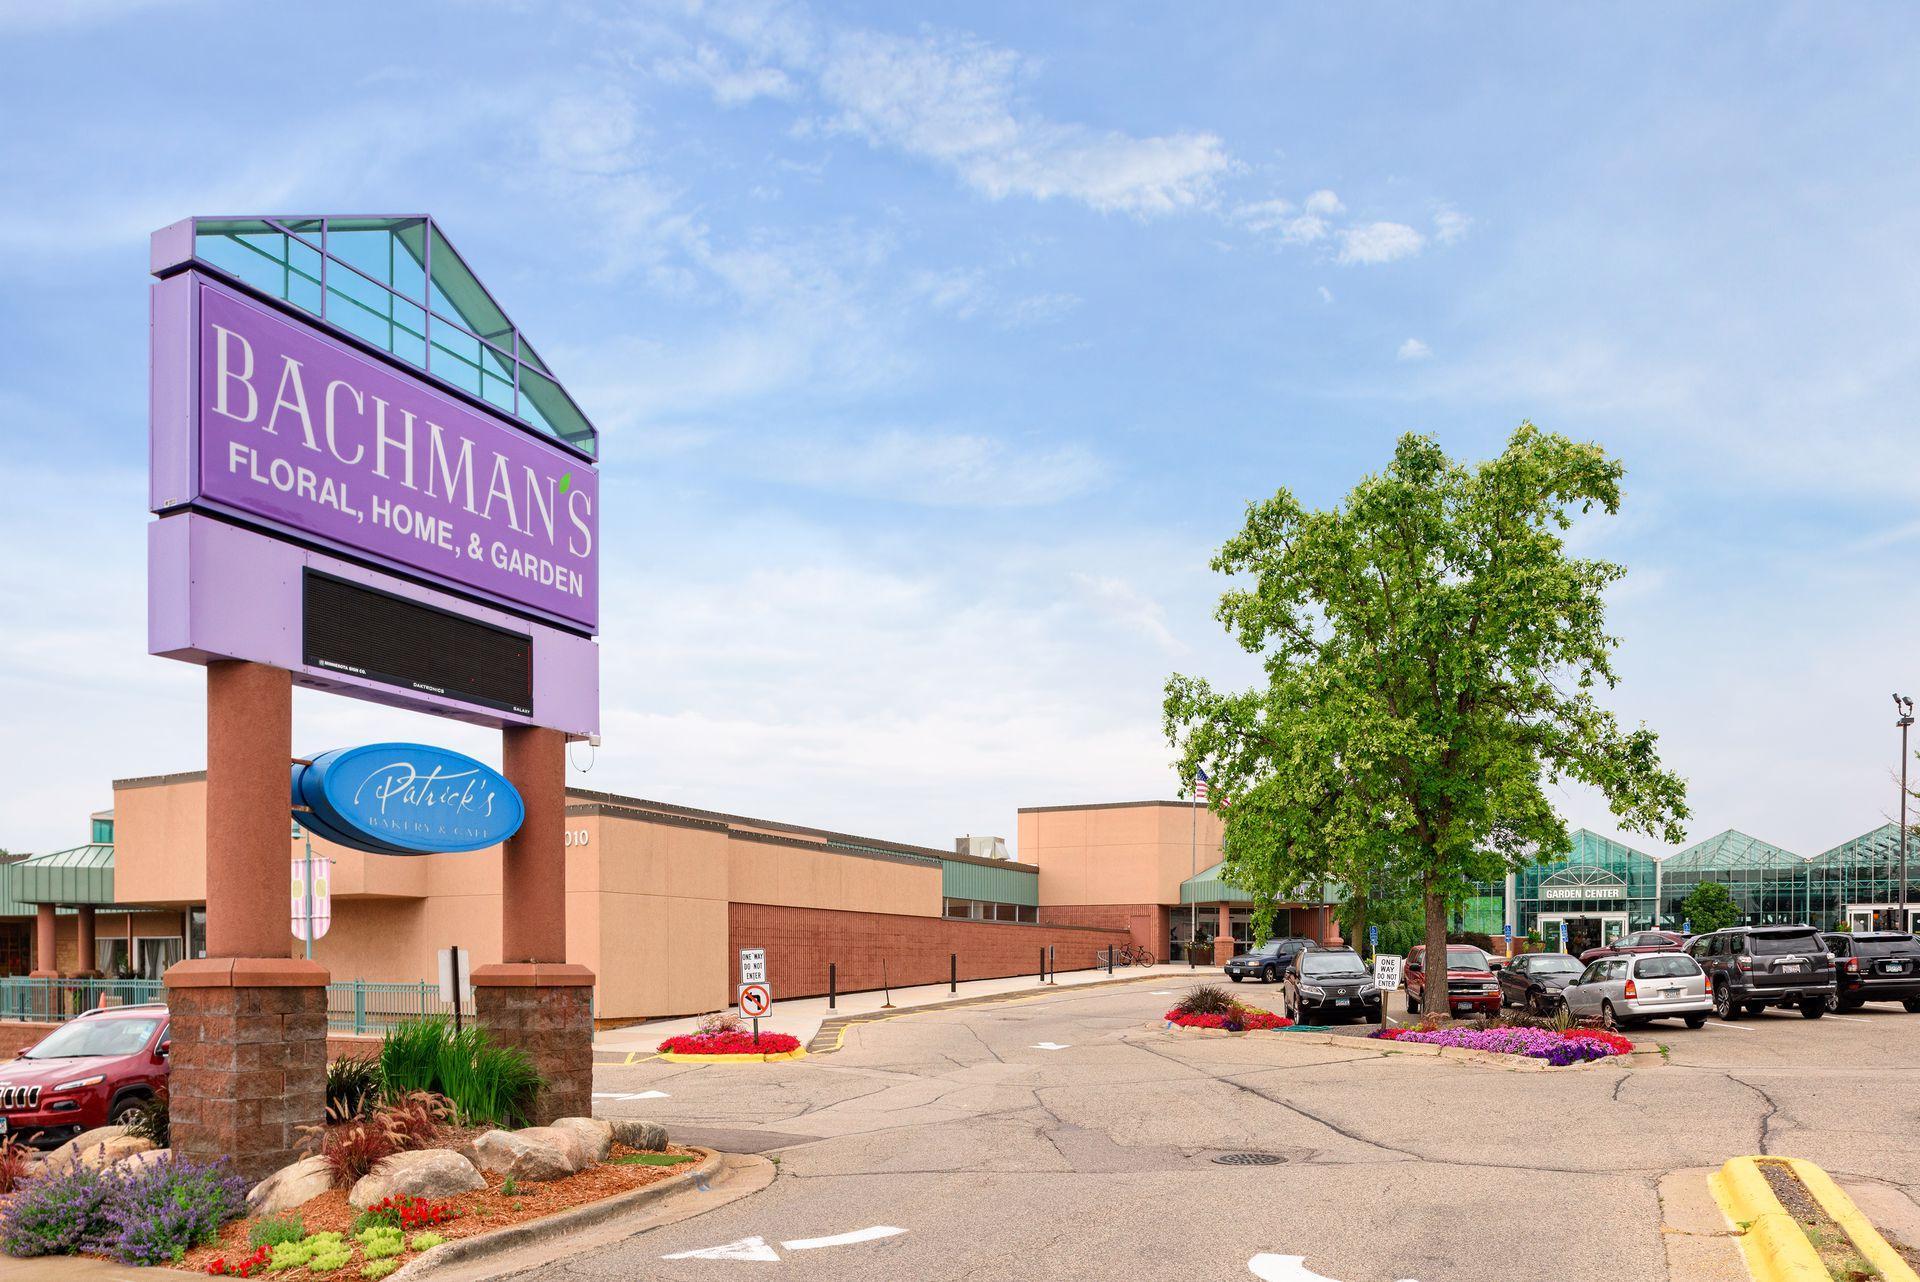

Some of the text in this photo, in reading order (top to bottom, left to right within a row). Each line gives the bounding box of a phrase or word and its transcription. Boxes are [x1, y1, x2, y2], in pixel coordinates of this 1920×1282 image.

[211, 324, 593, 559] BACHMAN'S
[229, 441, 584, 598] FLORAL, HOME, & GARDEN
[413, 682, 445, 694] DAKTRONICS
[513, 706, 531, 714] GALAXY
[354, 762, 496, 818] Patrick's
[369, 816, 431, 833] BAKERY
[438, 825, 447, 835] &
[1546, 888, 1620, 899] GARDEN CENTER
